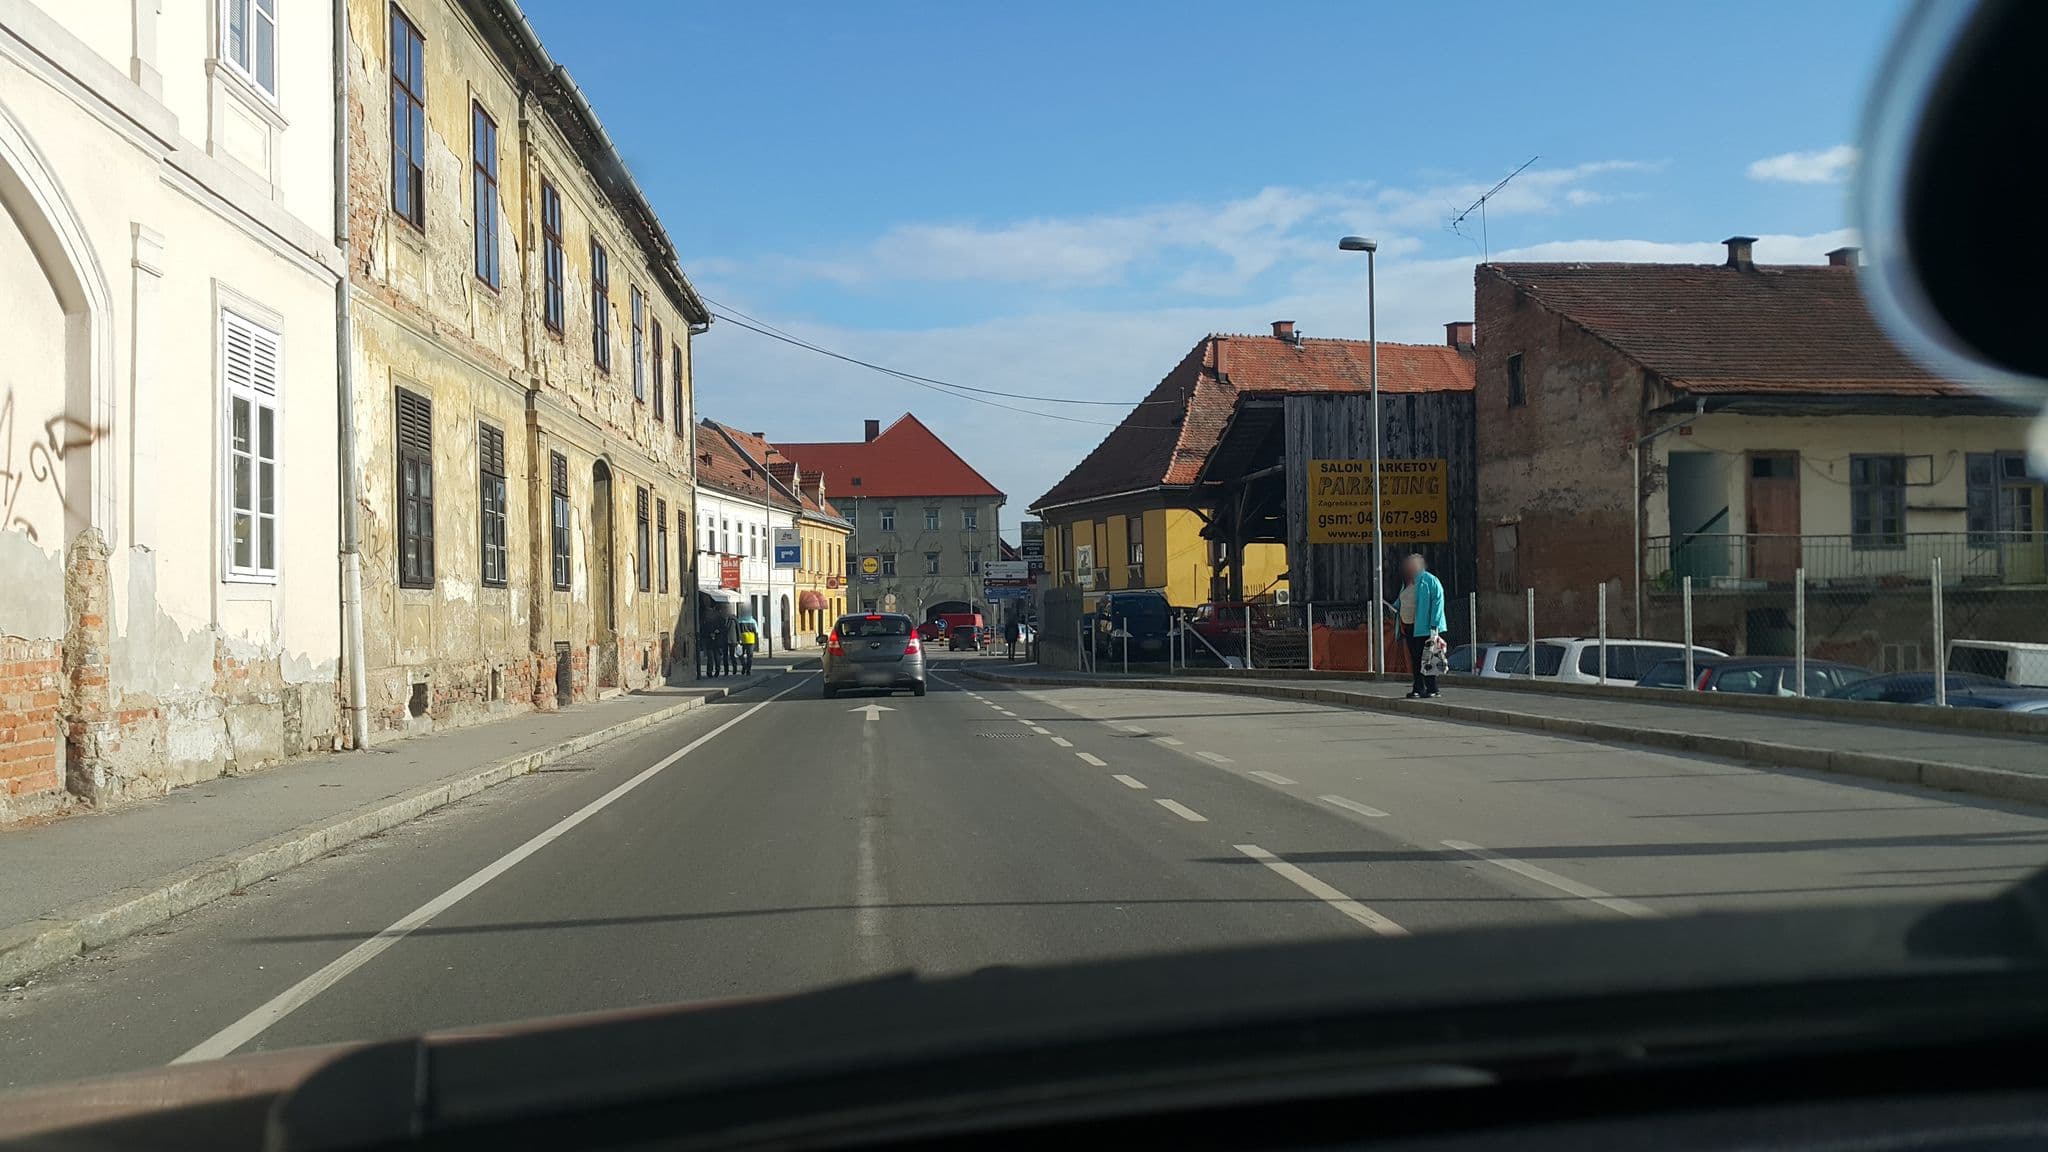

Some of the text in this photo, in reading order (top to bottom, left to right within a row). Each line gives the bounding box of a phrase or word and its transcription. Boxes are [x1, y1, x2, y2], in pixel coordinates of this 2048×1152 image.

[1321, 463, 1362, 473] SALON
[1318, 476, 1440, 496] PARKETING
[1318, 511, 1438, 527] gsm: 04/677-989
[1328, 529, 1431, 539] www.paketing.si
